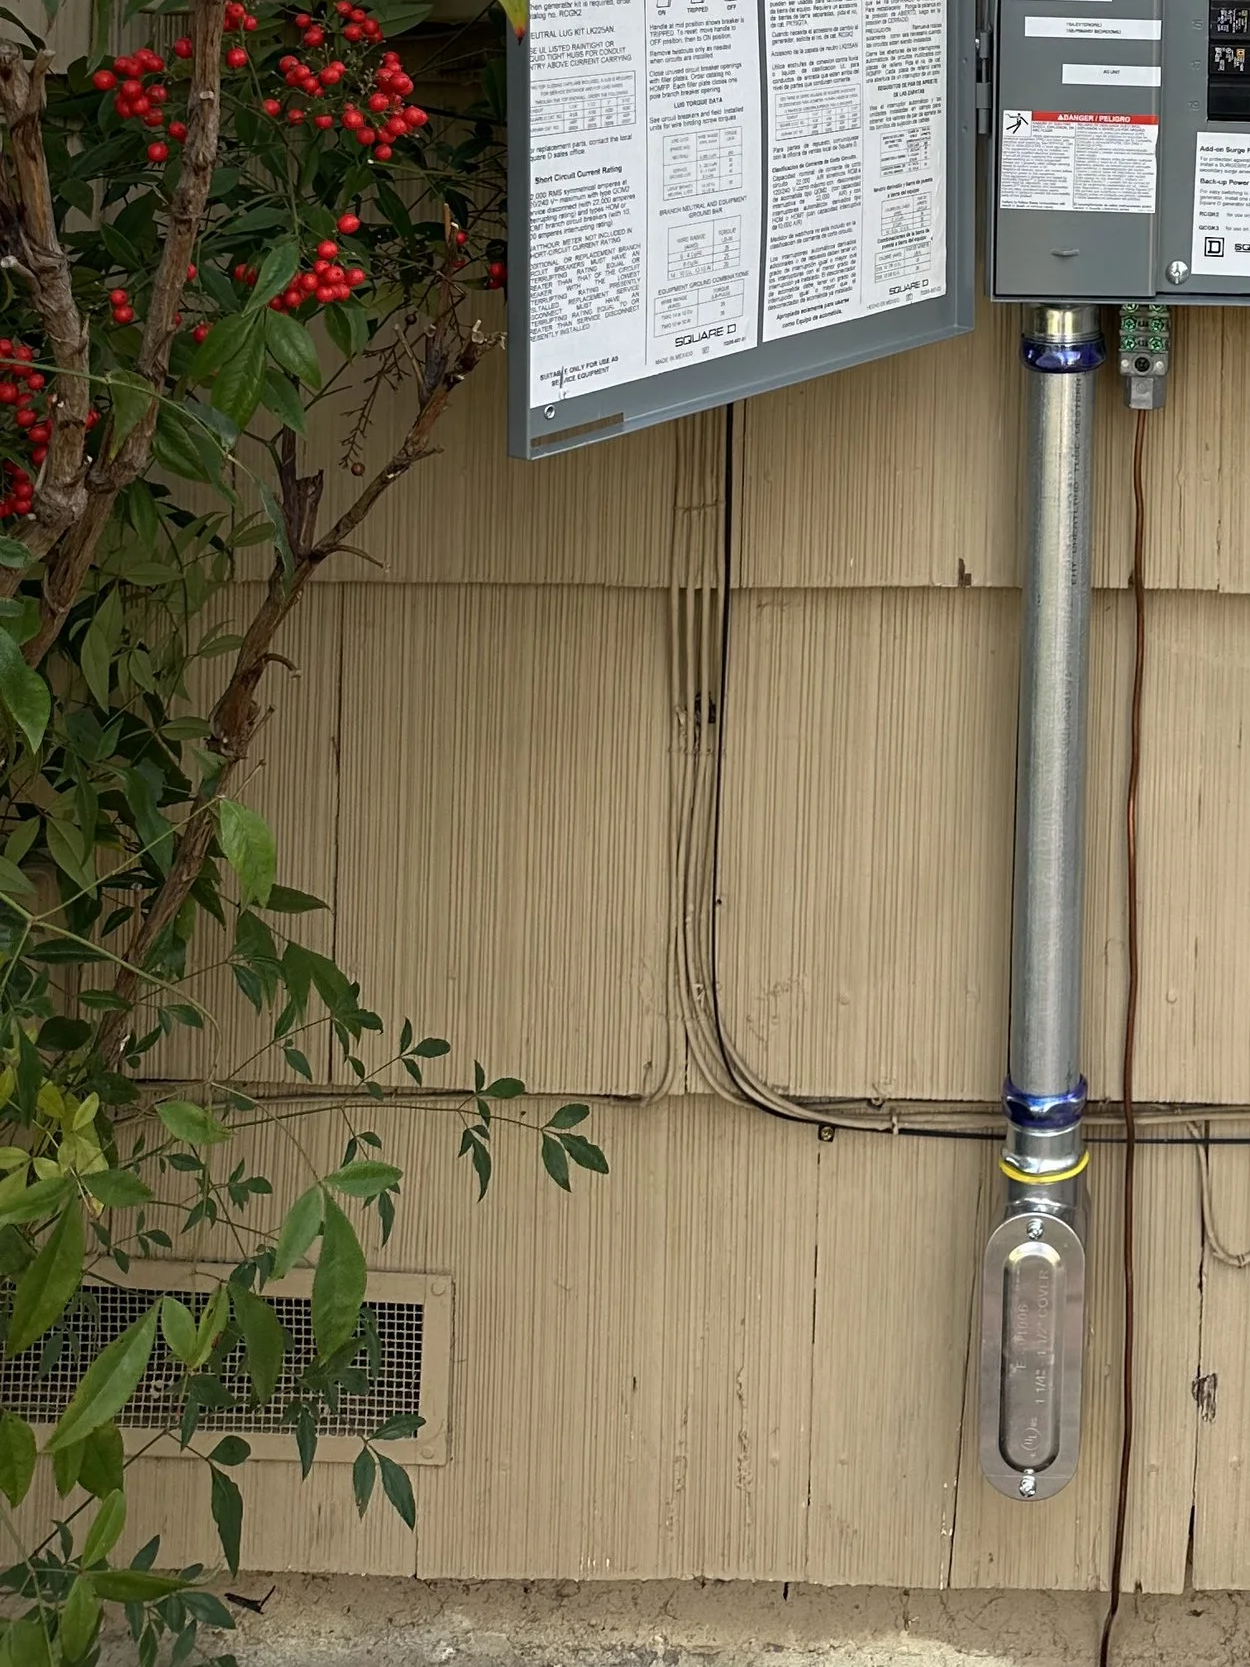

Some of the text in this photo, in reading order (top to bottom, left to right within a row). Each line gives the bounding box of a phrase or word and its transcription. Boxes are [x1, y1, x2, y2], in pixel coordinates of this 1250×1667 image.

[547, 52, 565, 60] TIGHT
[600, 47, 626, 55] CONDUIT
[1063, 114, 1095, 122] DANGER
[1099, 115, 1131, 123] PELIGRO
[535, 165, 623, 184] Short Circuit Current Rating
[1200, 178, 1227, 186] Back-up
[888, 278, 929, 296] SQUARE D
[675, 323, 737, 348] SQUARE D
[569, 364, 586, 375] ONLY
[586, 361, 598, 371] FOR
[599, 357, 610, 368] USE
[611, 355, 619, 363] AS
[655, 357, 669, 366] MADE
[675, 350, 694, 361] MEXICO
[577, 366, 610, 380] EQUIPMENT
[1038, 1269, 1049, 1318] COVER
